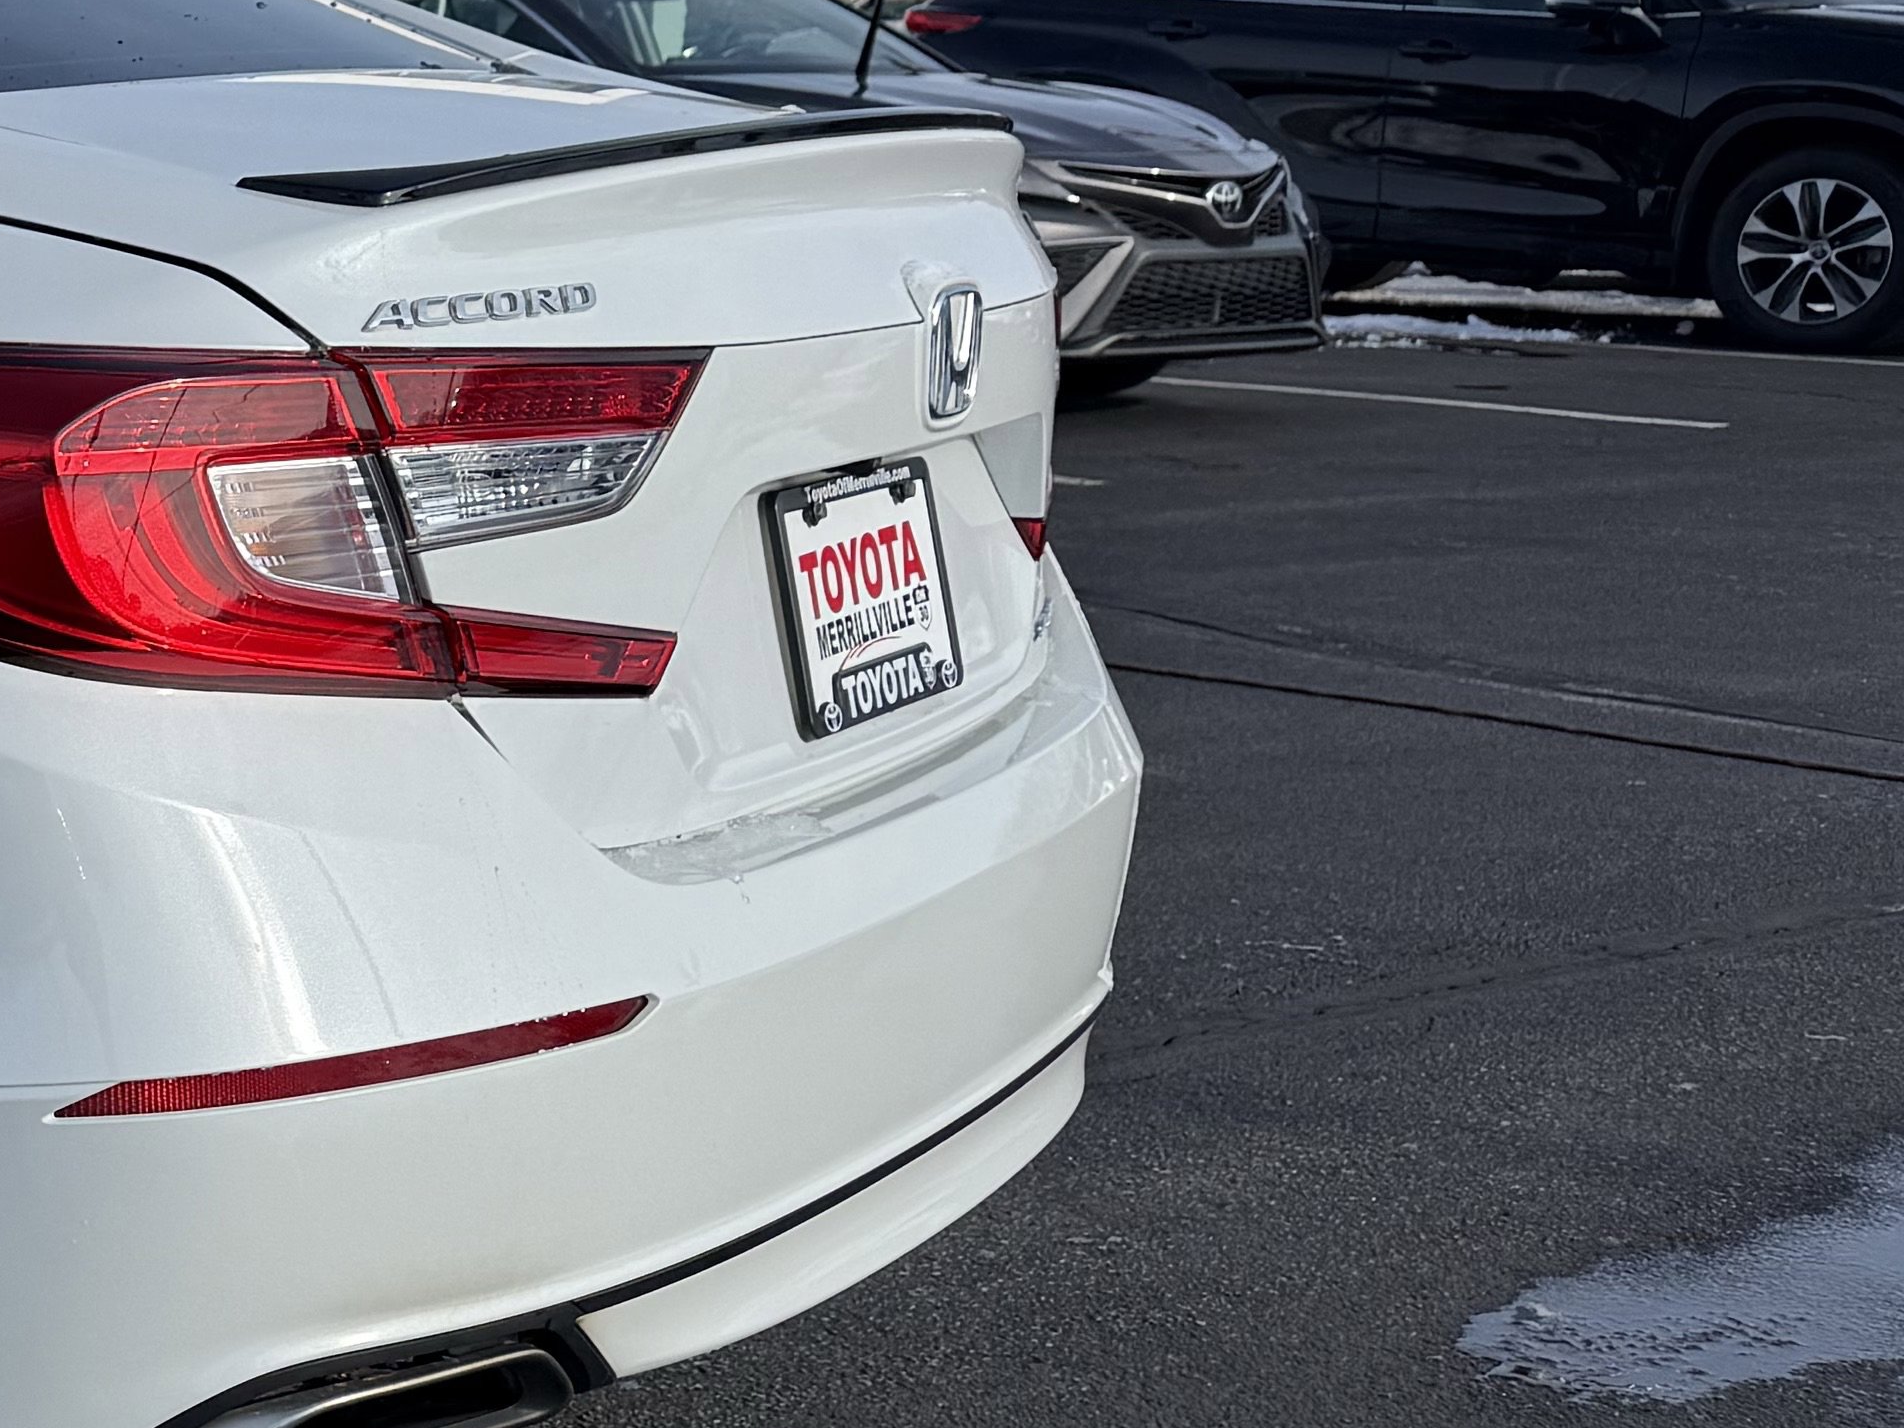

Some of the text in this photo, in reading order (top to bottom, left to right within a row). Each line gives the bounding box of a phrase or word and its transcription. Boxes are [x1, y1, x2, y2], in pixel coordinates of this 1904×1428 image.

[360, 281, 597, 333] ACCORD
[798, 520, 928, 620] TOYOTA
[815, 593, 915, 661] MERRILLVILLE
[841, 653, 924, 720] TOYOTA
